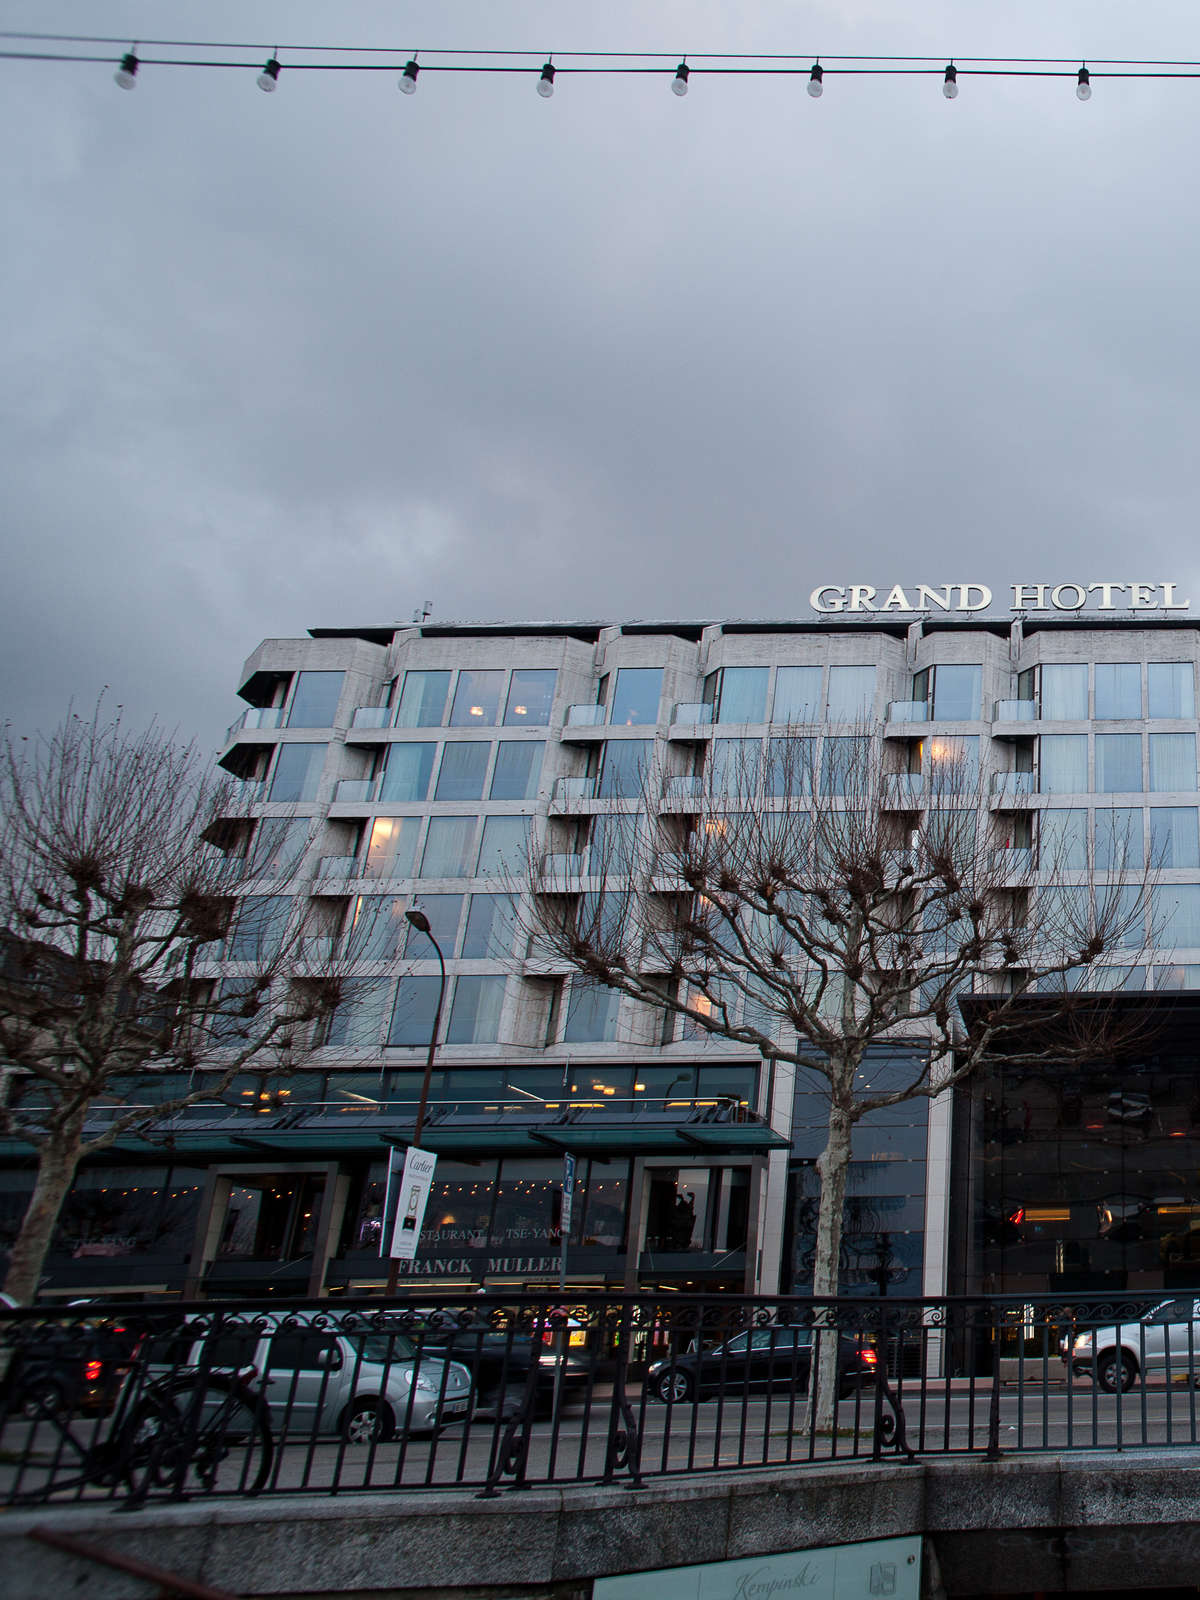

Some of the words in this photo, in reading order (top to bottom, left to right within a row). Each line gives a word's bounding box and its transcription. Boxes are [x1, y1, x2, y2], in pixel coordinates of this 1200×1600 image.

[809, 583, 993, 613] GRAND
[1010, 582, 1190, 611] HOTEL
[409, 1153, 434, 1173] Cartier
[420, 1229, 484, 1241] STAURANT
[398, 1258, 472, 1274] FRANCK
[487, 1257, 562, 1273] MULLER
